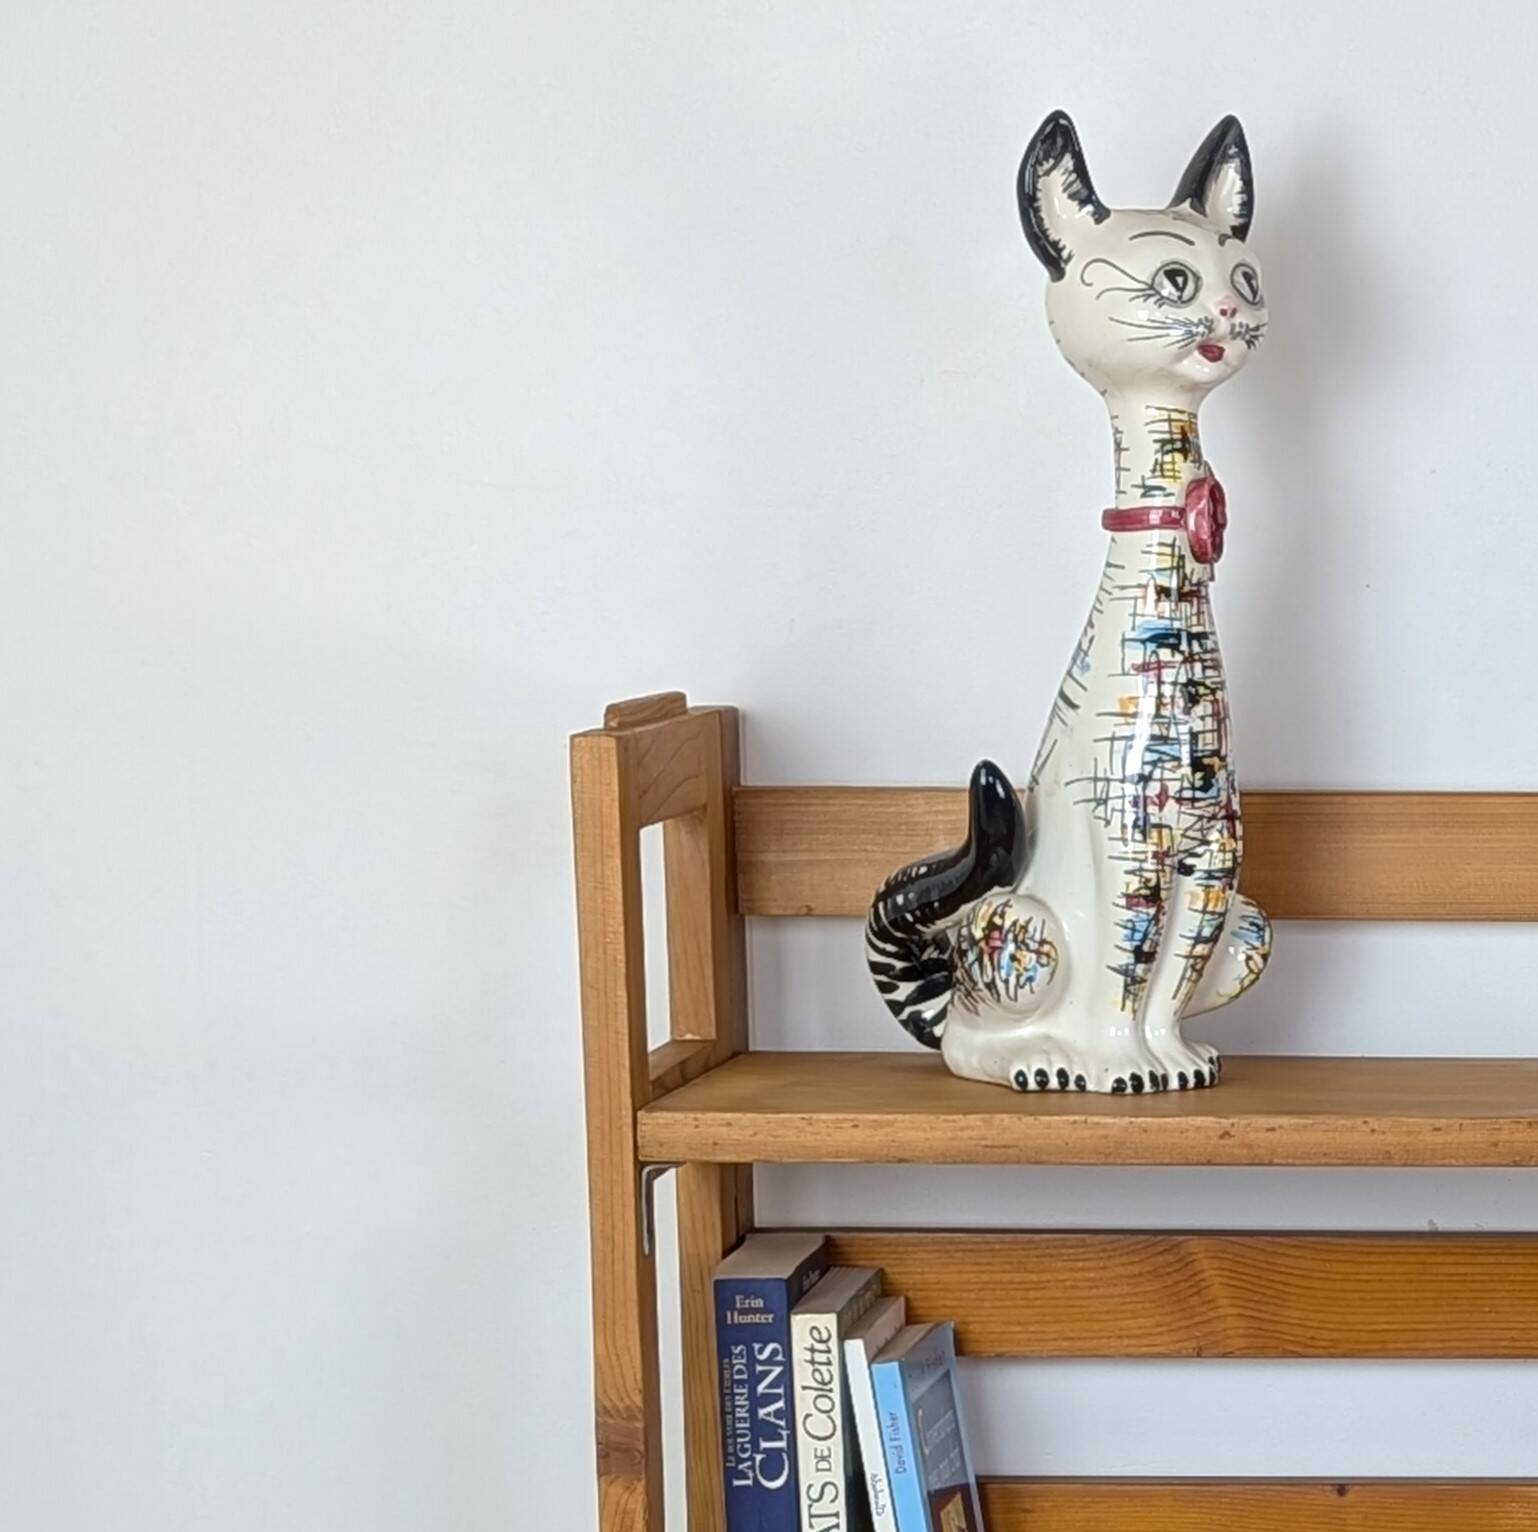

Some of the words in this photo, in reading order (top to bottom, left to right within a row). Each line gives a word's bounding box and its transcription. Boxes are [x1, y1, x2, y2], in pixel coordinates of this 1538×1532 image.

[735, 1295, 764, 1309] Erin
[726, 1311, 775, 1325] Hunter
[731, 1344, 748, 1379] DES
[801, 1325, 837, 1442] Colette
[733, 1384, 752, 1459] GUERRE
[752, 1342, 791, 1490] CLANS
[888, 1411, 901, 1441] Fisher
[732, 1460, 754, 1487] LA
[814, 1446, 832, 1472] DE
[893, 1443, 908, 1474] David
